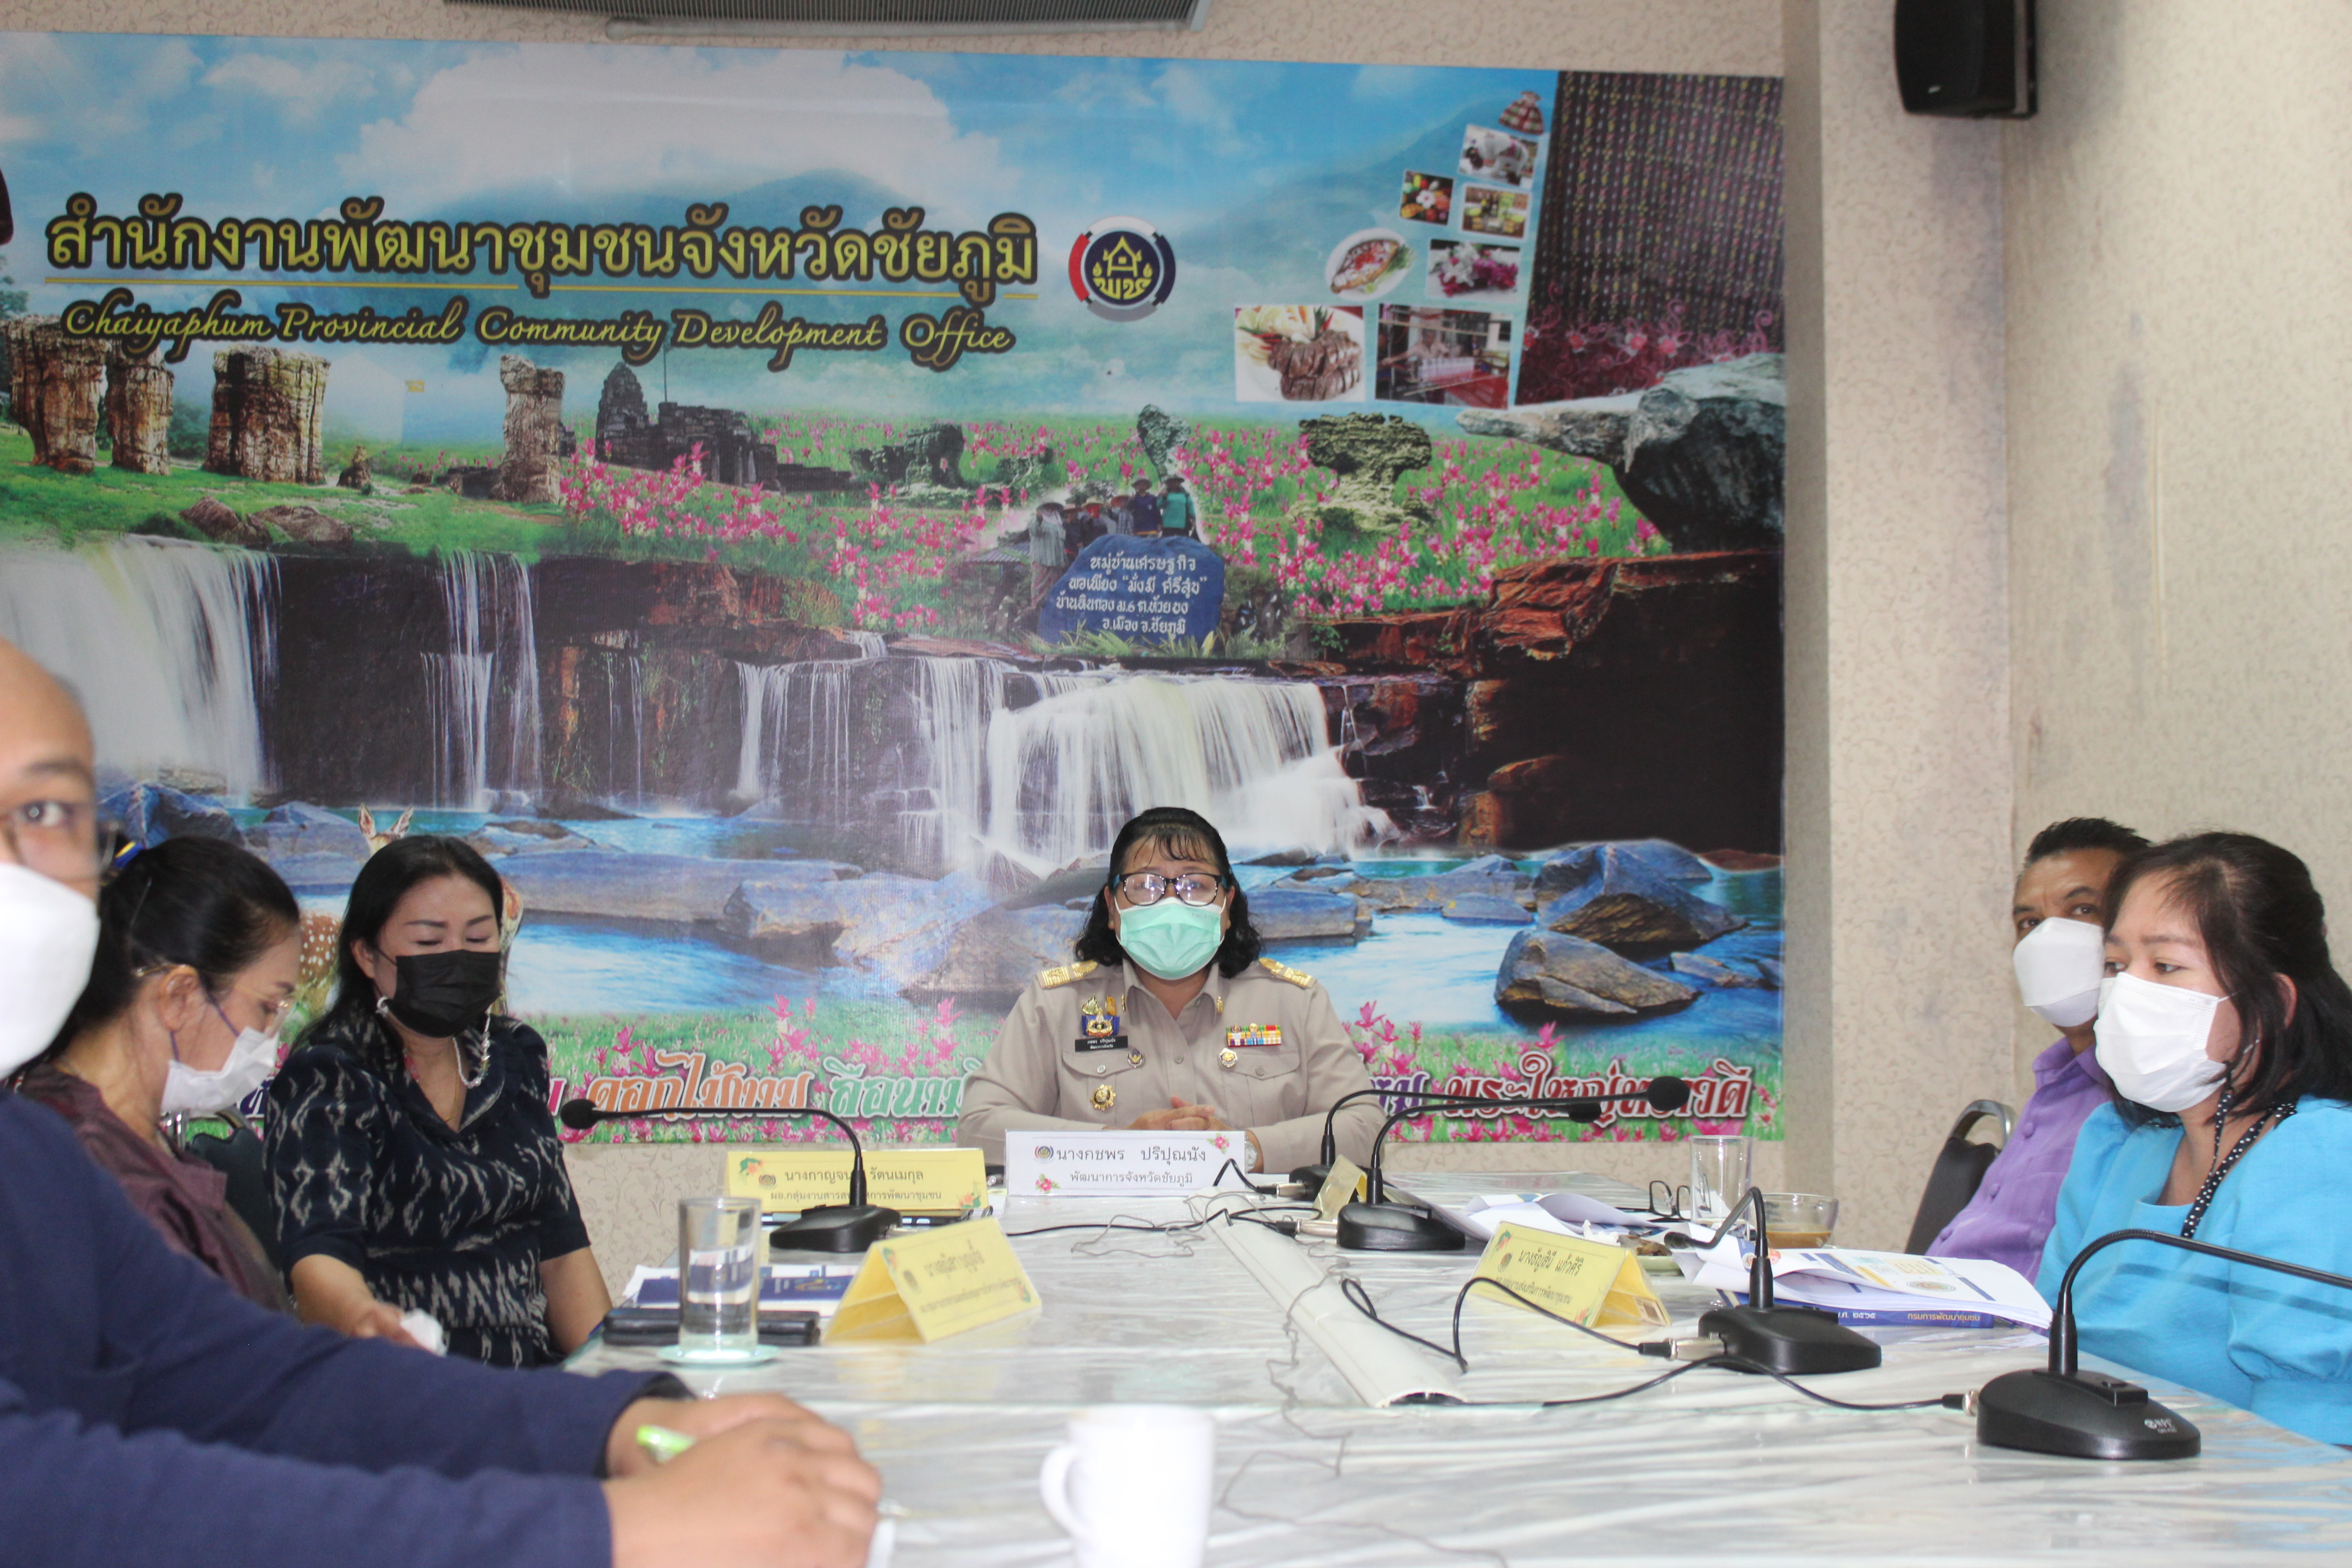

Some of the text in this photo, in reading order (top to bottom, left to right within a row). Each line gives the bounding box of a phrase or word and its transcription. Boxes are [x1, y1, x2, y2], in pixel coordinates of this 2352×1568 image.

[47, 194, 1036, 304] สำนักงานพัฒนาชุมชนจังหวัดชัยภูมิ
[63, 289, 1014, 371] Chaiyaphum Provincial Community Development Office
[1069, 573, 1117, 592] พอเพียง
[1057, 1146, 1206, 1166] นางกชพร ปริปุณนัง
[785, 1171, 852, 1184] นางกาญจน
[1070, 1171, 1193, 1187] พัฒนาการจังหวัดชัยภูมิ
